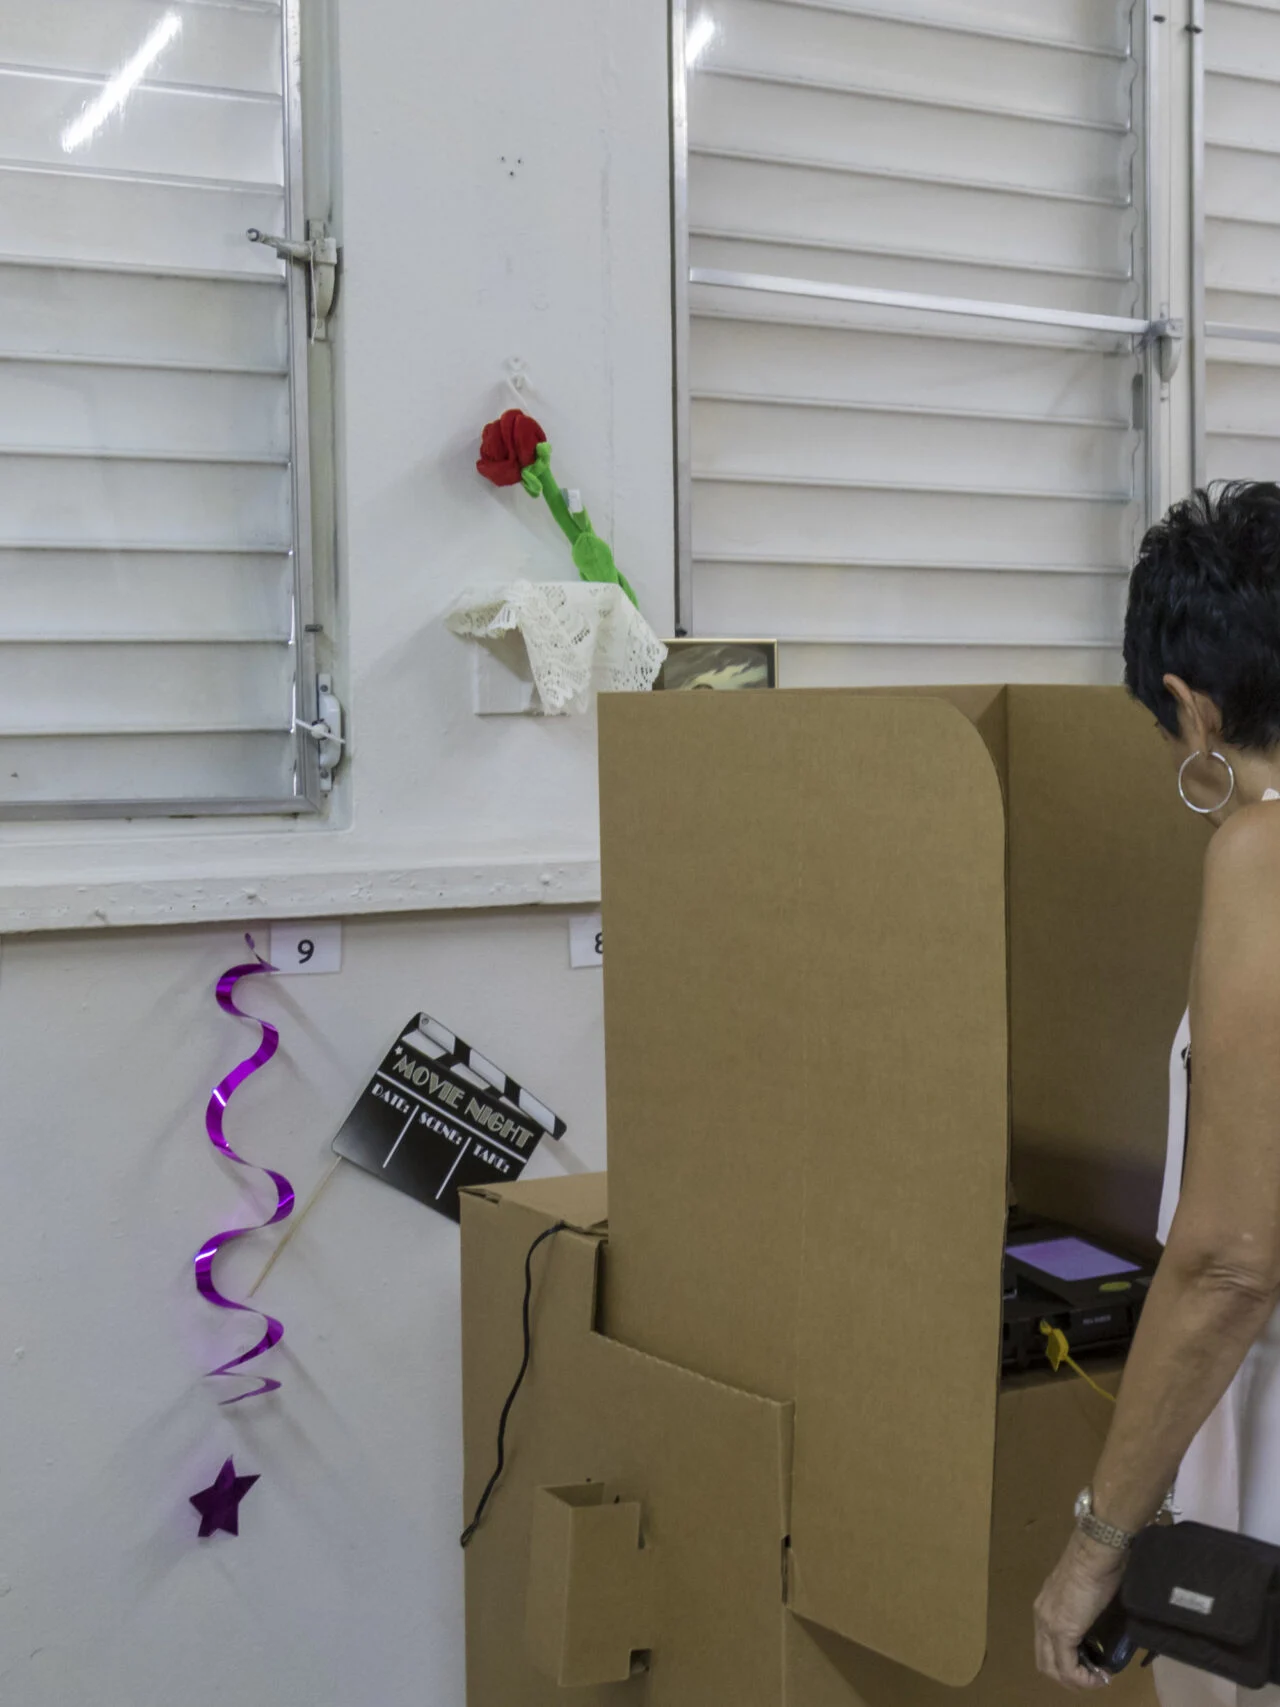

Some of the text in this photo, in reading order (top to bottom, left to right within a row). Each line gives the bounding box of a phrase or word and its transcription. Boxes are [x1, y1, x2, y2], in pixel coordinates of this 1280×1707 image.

[297, 939, 315, 964] 9
[371, 1083, 410, 1114] DATE:
[392, 1054, 534, 1149] MOVIE NIGHT
[418, 1111, 462, 1145] SCENE:
[473, 1144, 510, 1173] TAKE:
